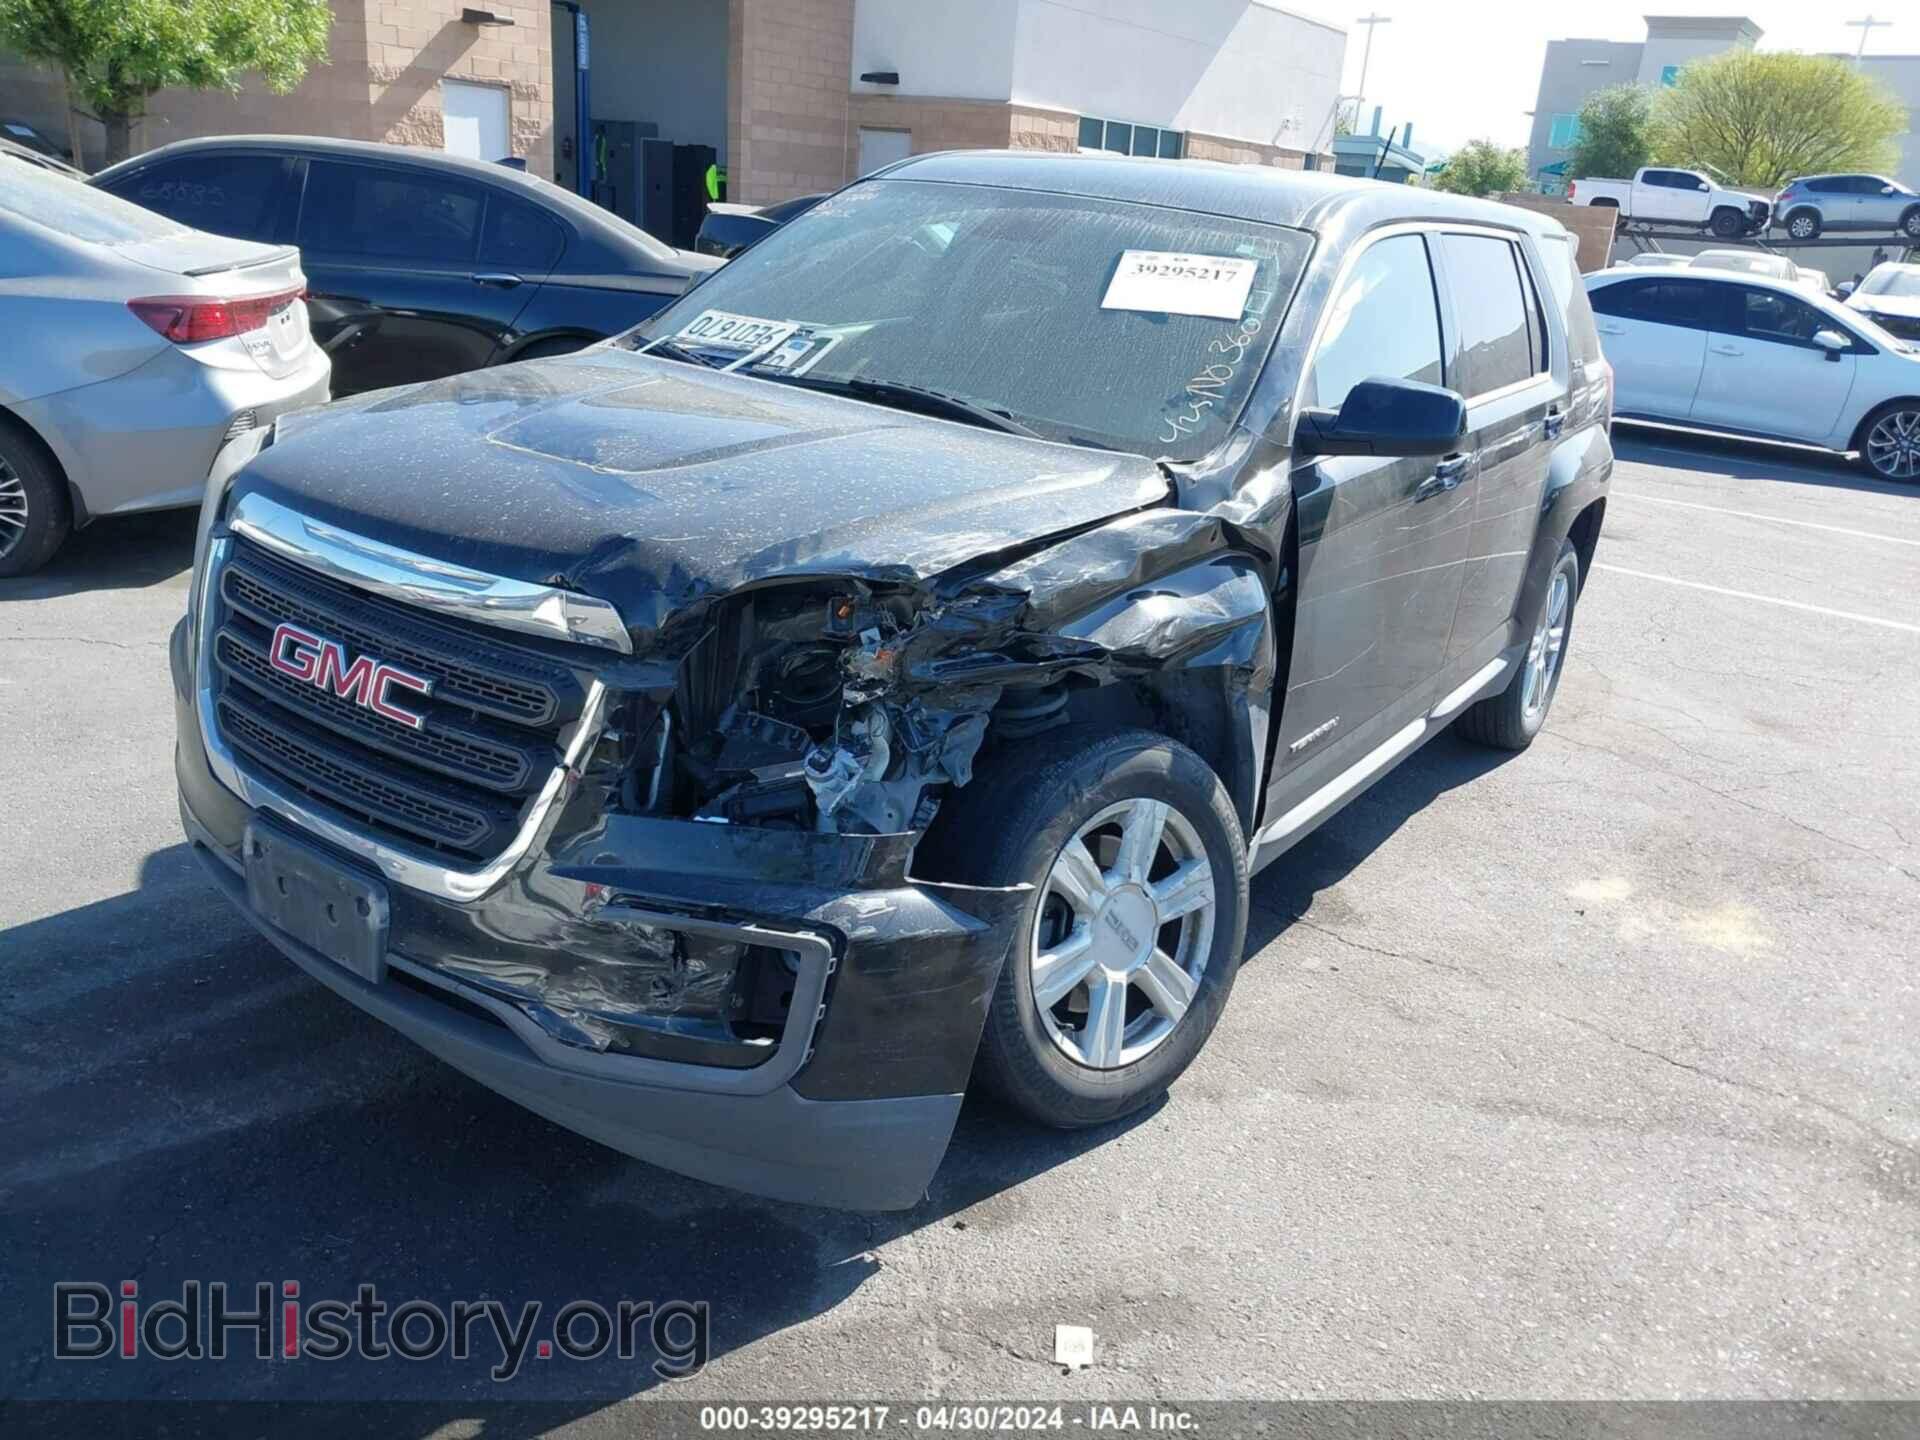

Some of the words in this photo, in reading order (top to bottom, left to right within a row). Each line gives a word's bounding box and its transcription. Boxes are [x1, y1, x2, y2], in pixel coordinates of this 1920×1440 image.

[1131, 263, 1238, 281] 39295217
[1208, 317, 1262, 365] 360
[269, 622, 433, 730] GMC
